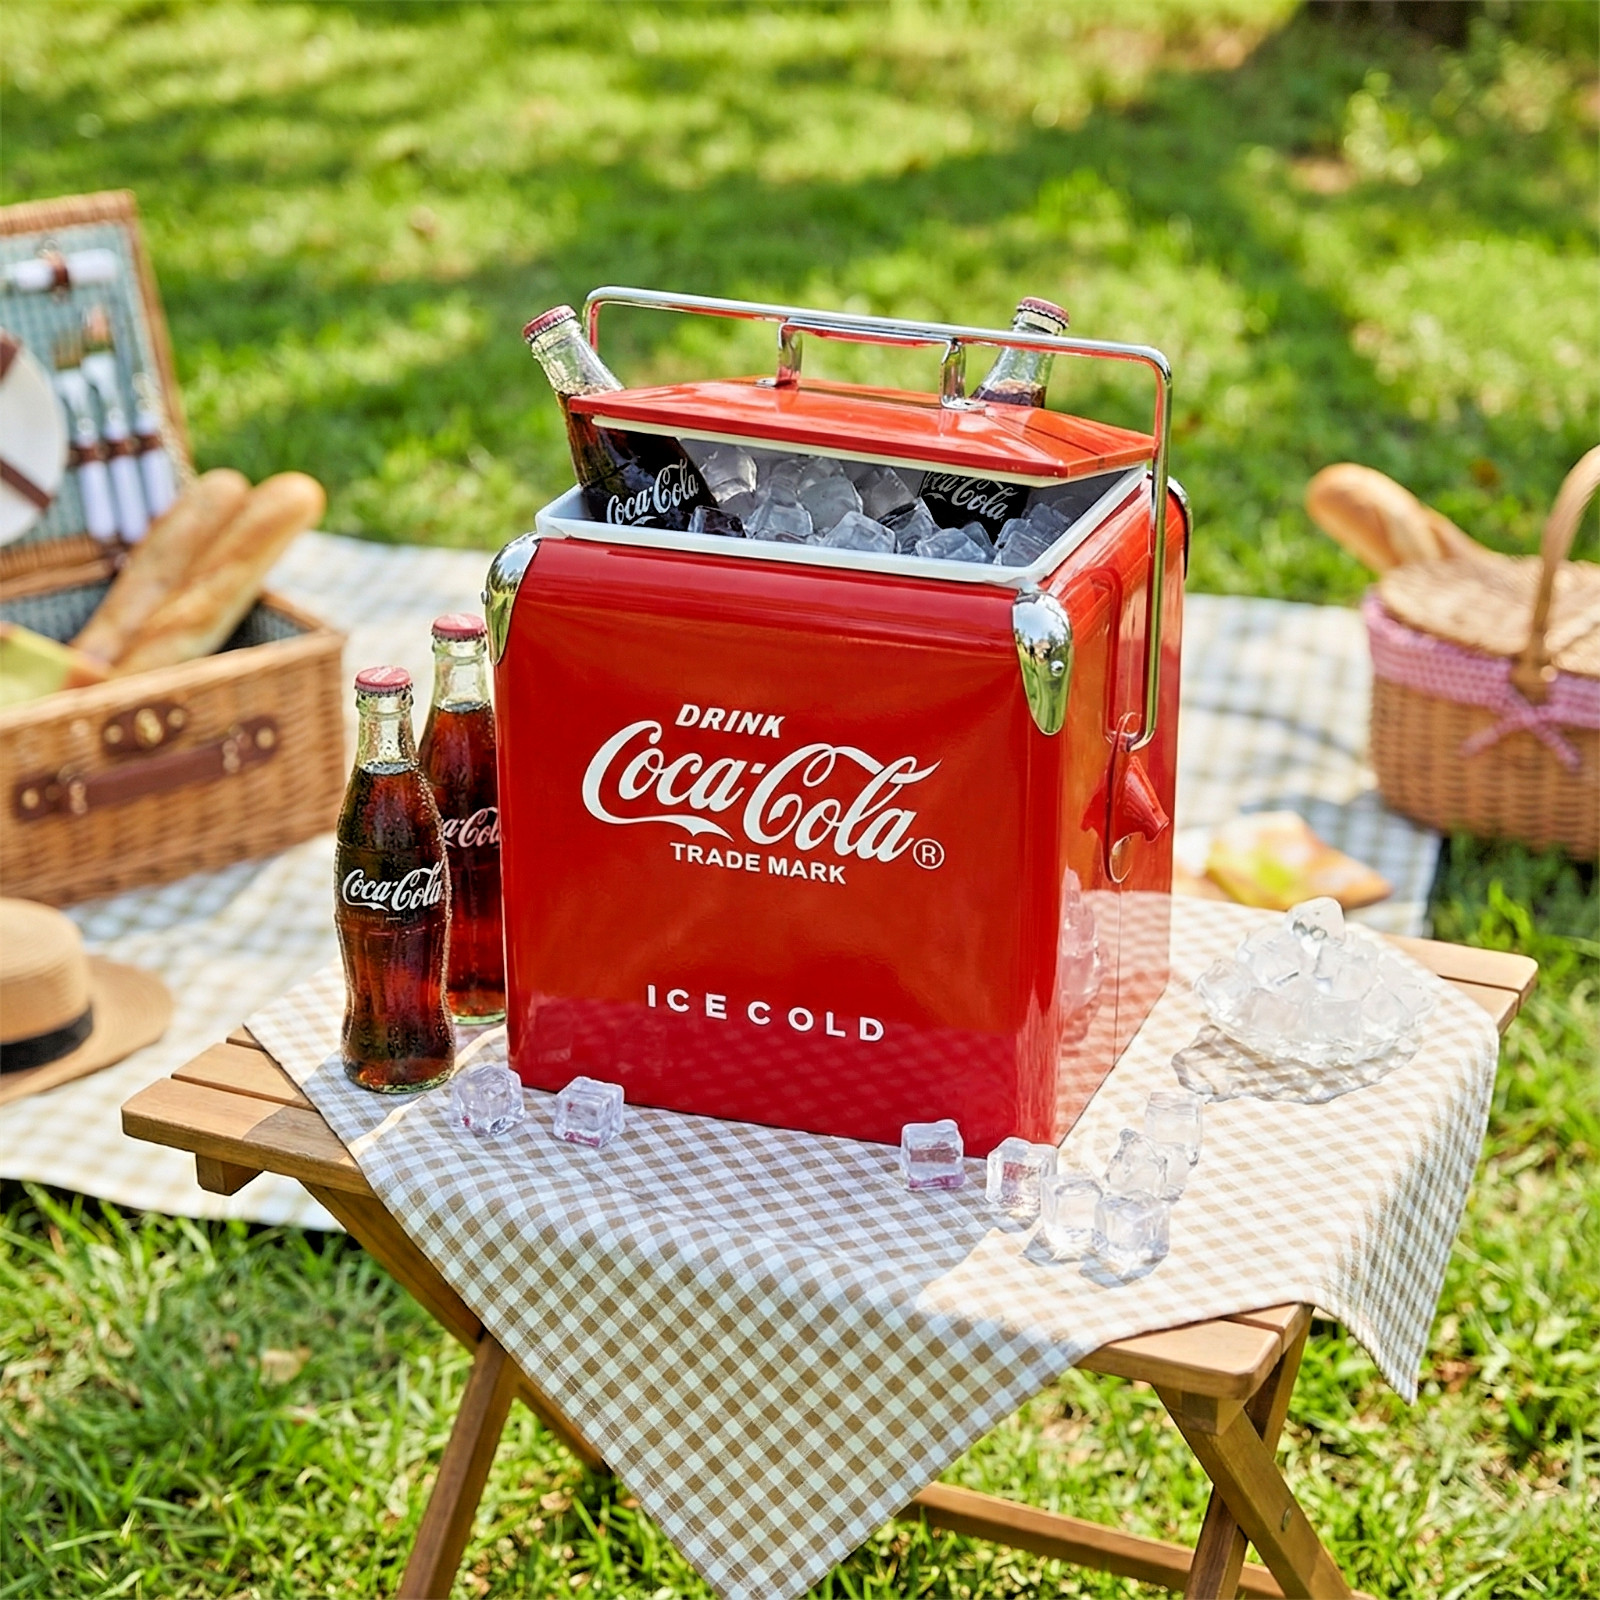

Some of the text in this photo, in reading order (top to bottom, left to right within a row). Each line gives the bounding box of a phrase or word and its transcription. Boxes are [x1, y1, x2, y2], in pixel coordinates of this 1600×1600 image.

[676, 704, 786, 739] DRINK
[582, 720, 943, 862] Coca-Cola
[342, 859, 443, 911] Coca-Cola
[670, 842, 847, 885] TRADE MARK
[647, 984, 885, 1042] ICE COLD
